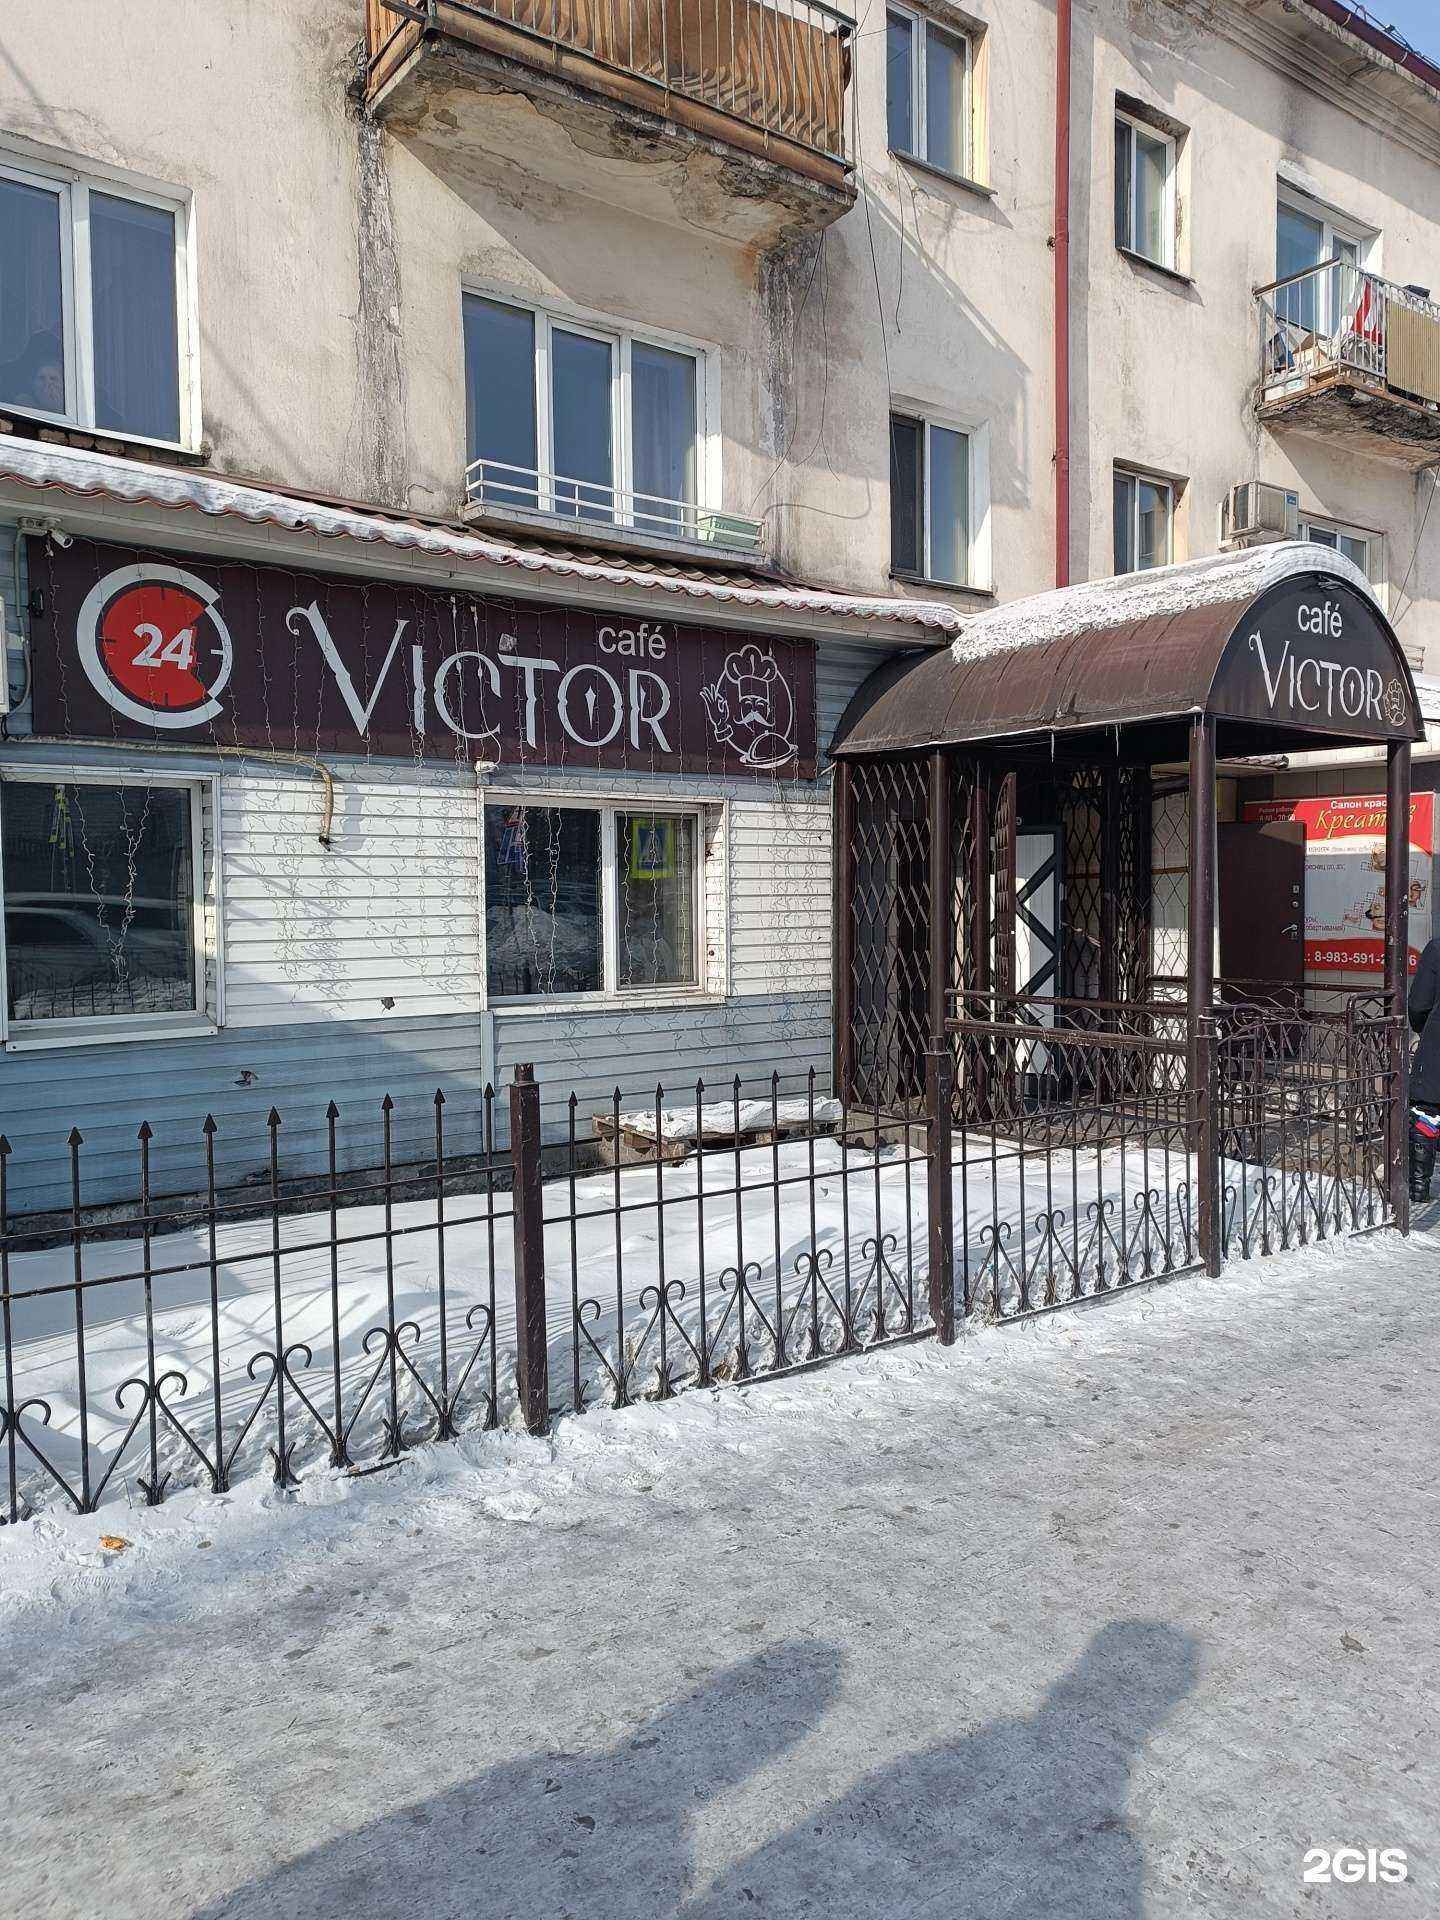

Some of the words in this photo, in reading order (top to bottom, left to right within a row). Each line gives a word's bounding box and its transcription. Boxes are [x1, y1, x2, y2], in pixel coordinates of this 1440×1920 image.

[1298, 601, 1343, 637] café
[132, 622, 194, 670] 24
[599, 624, 667, 660] café
[285, 599, 673, 753] VICTOR
[1248, 629, 1383, 721] VICTOR
[1330, 800, 1361, 810] Салон
